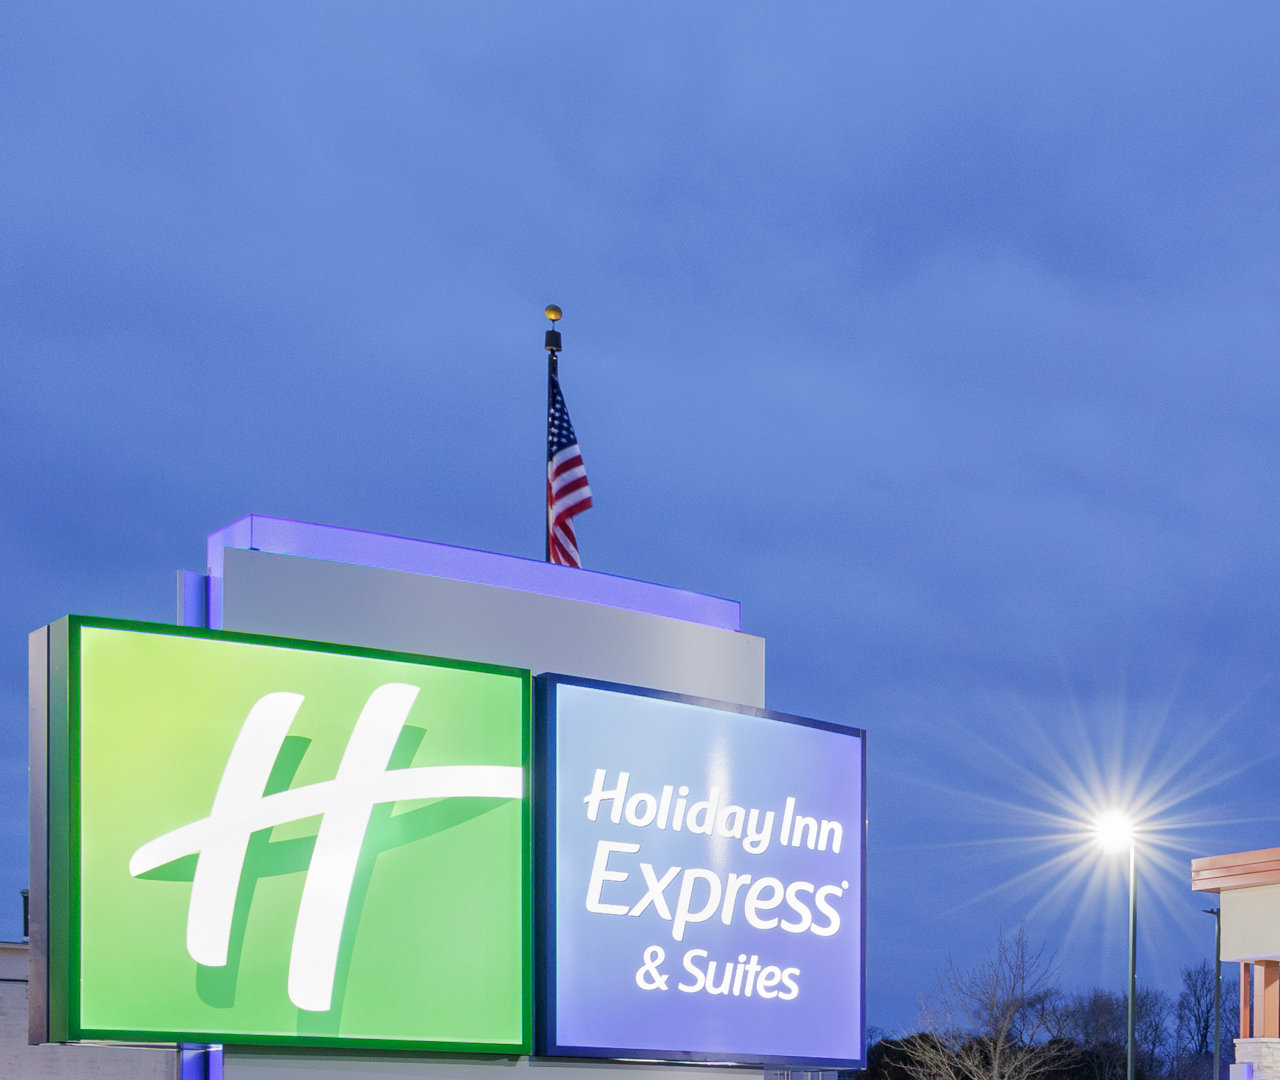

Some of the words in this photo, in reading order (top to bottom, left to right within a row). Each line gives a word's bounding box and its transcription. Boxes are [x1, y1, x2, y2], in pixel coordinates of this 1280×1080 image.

[583, 768, 776, 855] Holiday
[780, 796, 844, 854] Inn
[585, 839, 844, 942] Express
[635, 945, 670, 991] &
[677, 948, 801, 1001] Suites
